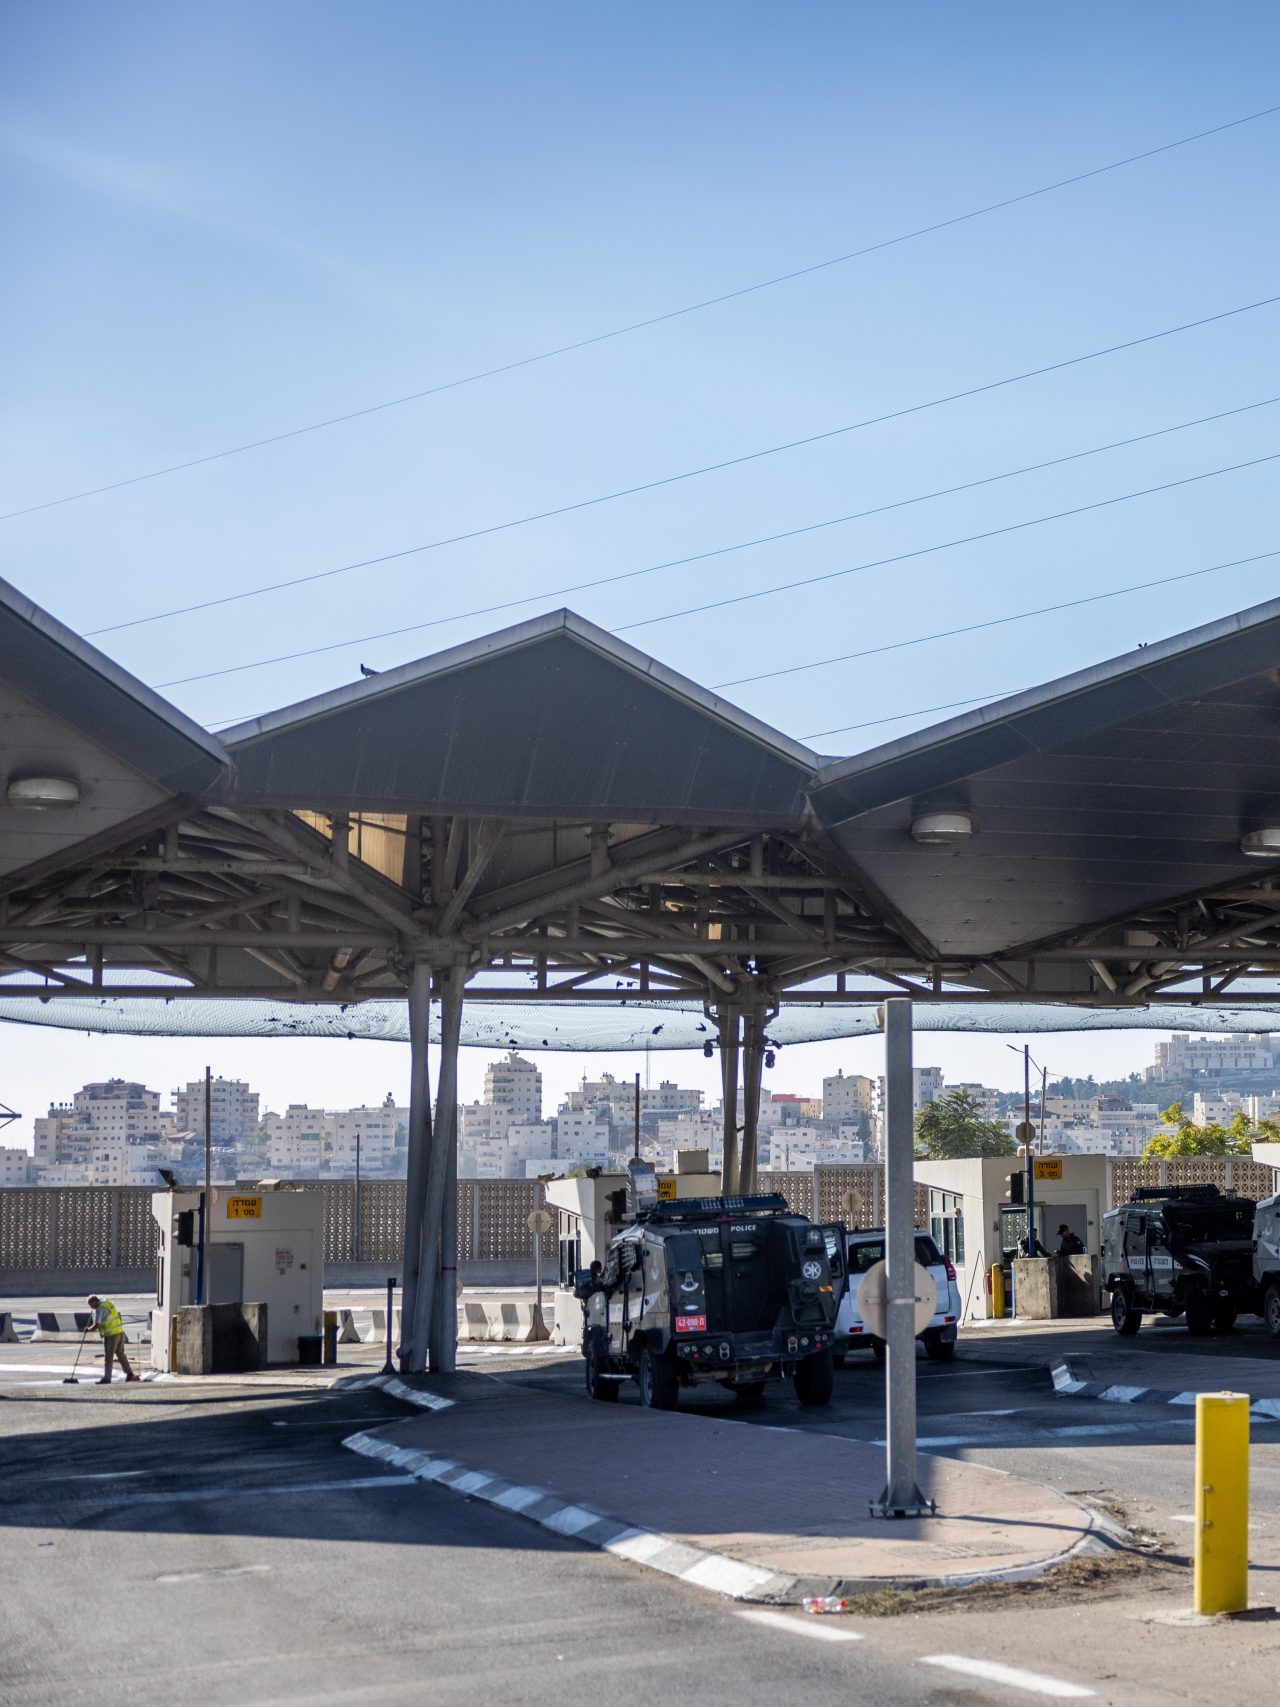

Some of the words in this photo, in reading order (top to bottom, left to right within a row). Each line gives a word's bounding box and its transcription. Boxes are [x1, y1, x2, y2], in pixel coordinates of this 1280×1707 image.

[233, 1199, 257, 1207] עמדה
[730, 1224, 757, 1232] POLICE
[1130, 1257, 1145, 1265] POLICE
[1153, 1257, 1169, 1265] משטרה
